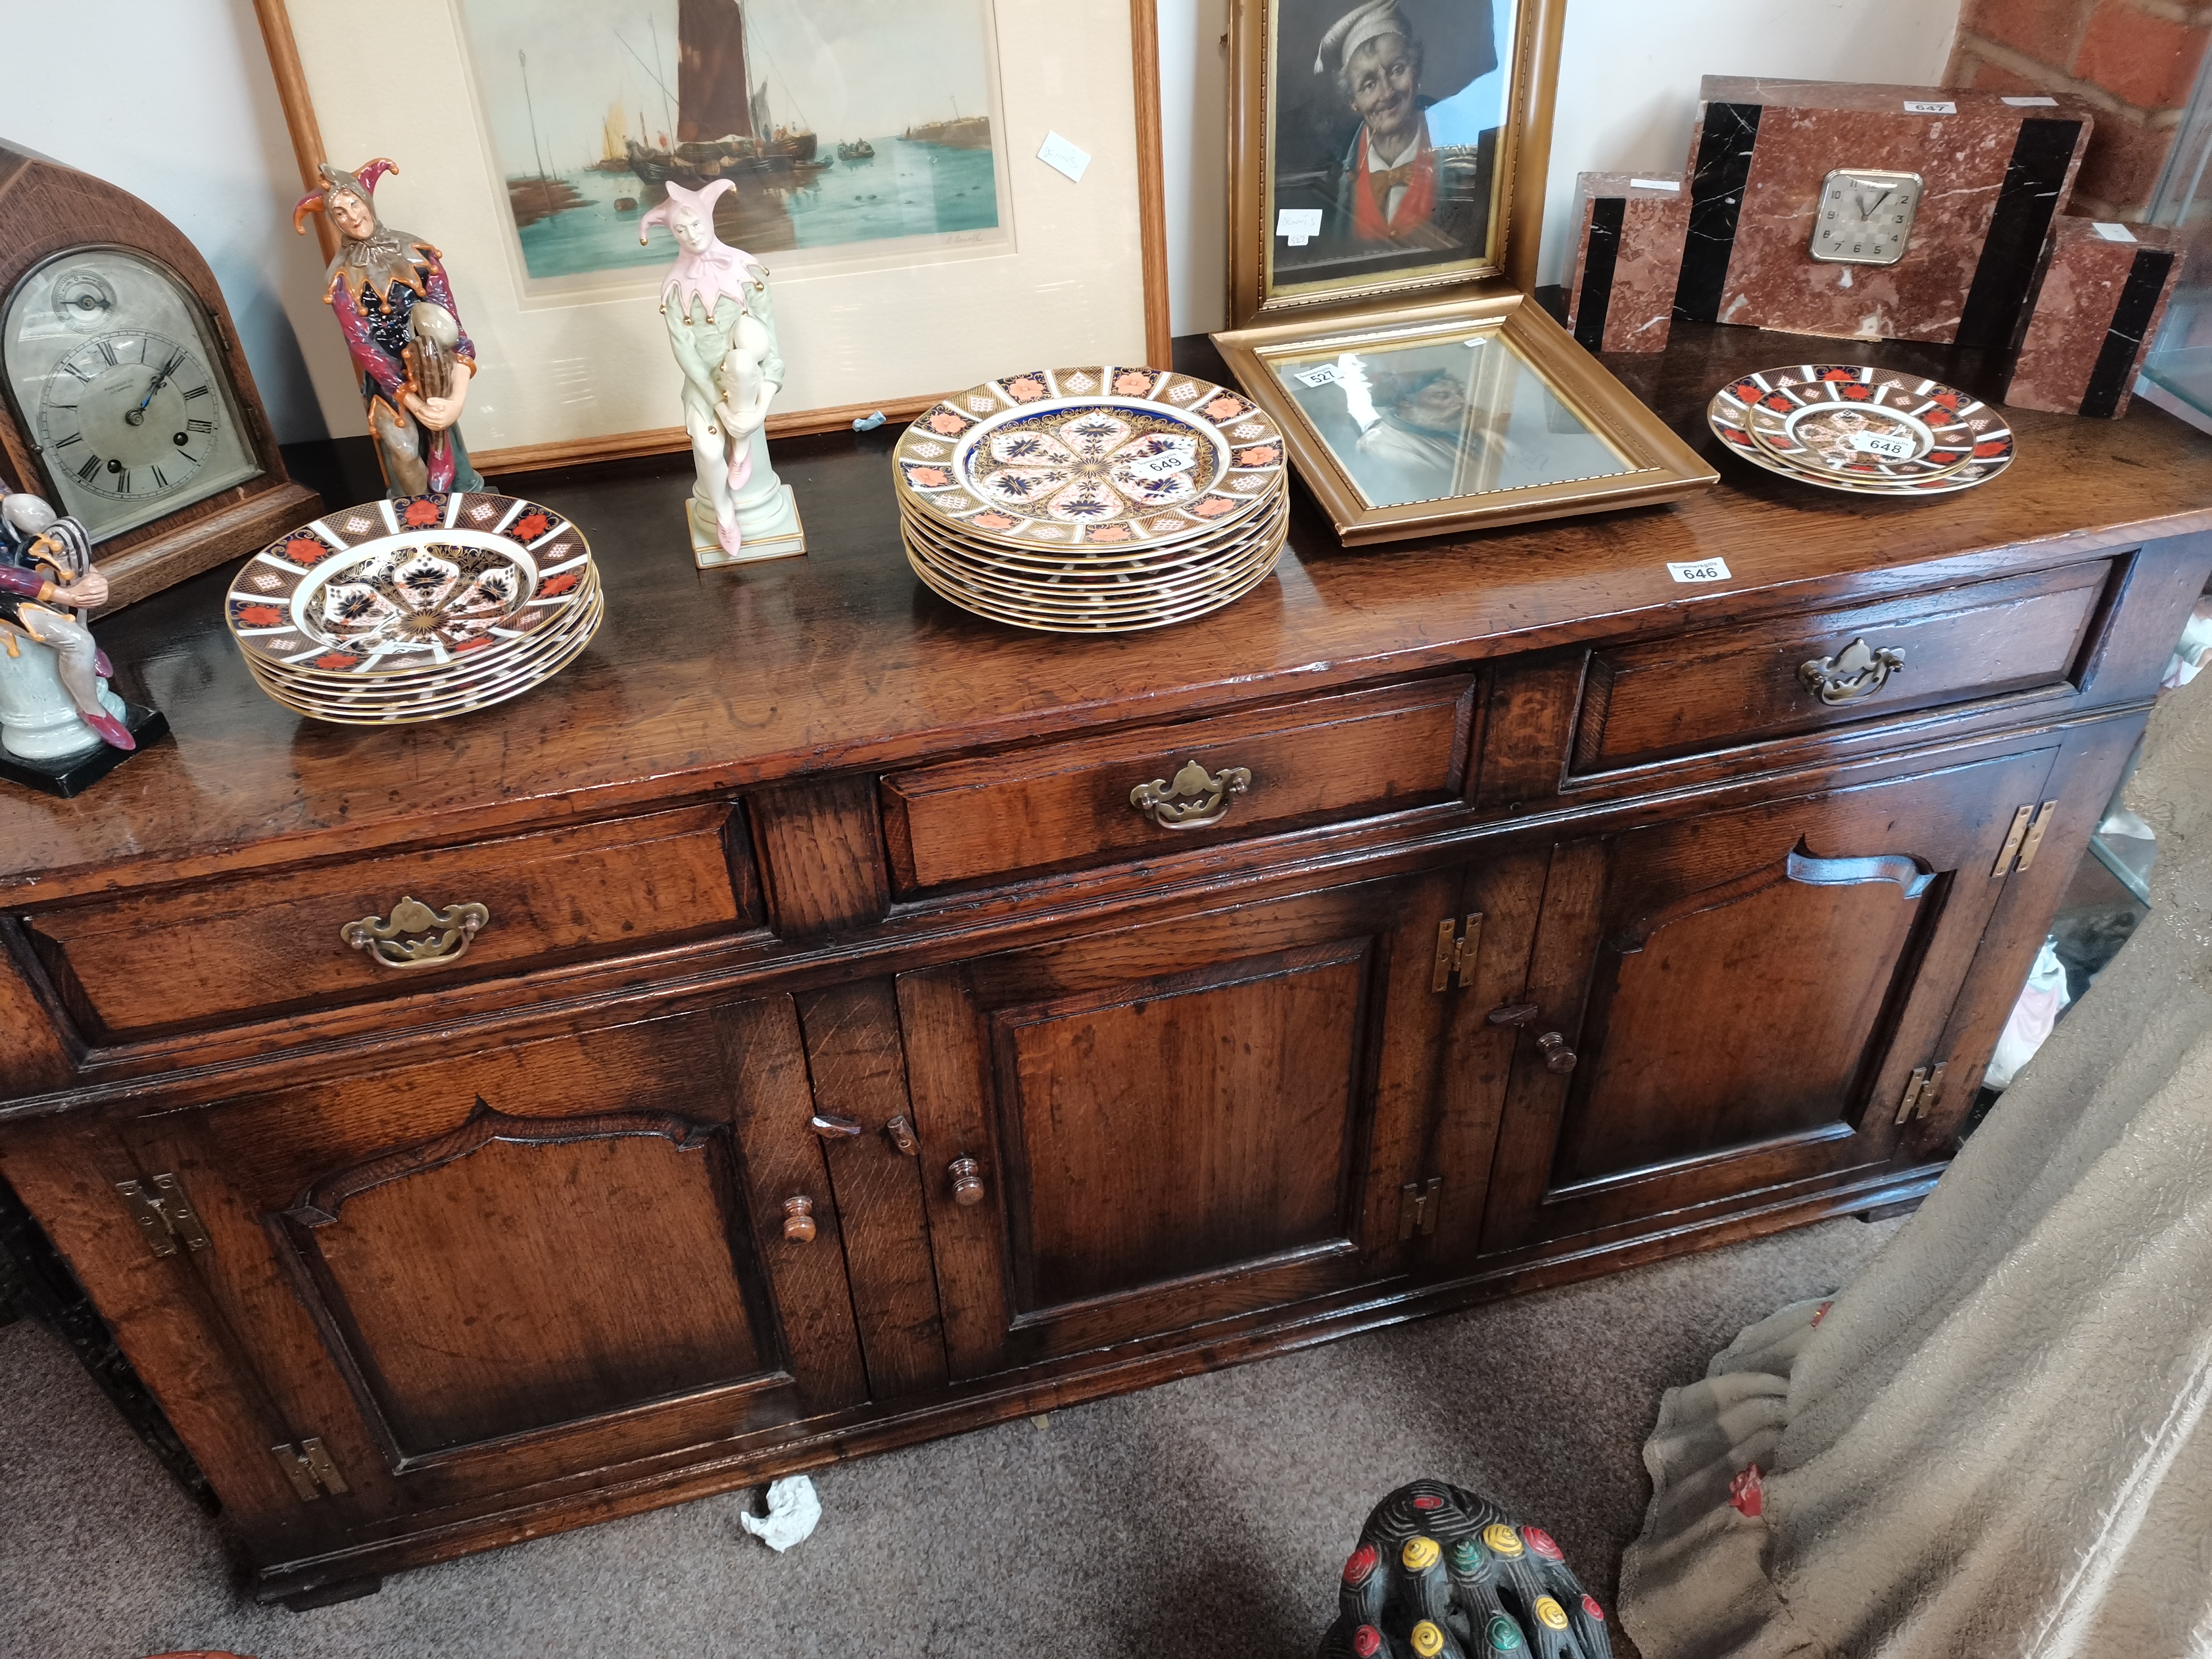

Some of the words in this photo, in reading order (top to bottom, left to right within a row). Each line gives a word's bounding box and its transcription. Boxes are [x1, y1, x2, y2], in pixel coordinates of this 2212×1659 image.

[1850, 180, 1858, 188] 11
[1831, 191, 1841, 199] 10
[1901, 196, 1909, 204] 2
[1827, 211, 1836, 219] 9
[1291, 236, 1305, 244] 527
[1823, 230, 1830, 239] 8
[1834, 243, 1842, 252] 7
[1853, 244, 1862, 252] 6
[1874, 246, 1882, 254] 5
[96, 339, 119, 369] XII
[141, 338, 148, 364] I
[1310, 371, 1335, 383] 527
[183, 385, 209, 401] III
[54, 432, 84, 449] IX
[1867, 433, 1909, 446] Summersgills
[1870, 440, 1902, 453] 648
[1137, 453, 1177, 465] Summersgills
[1150, 458, 1181, 471] 649
[77, 455, 104, 483] VIII
[151, 464, 169, 488] VI
[1683, 568, 1718, 579] 646
